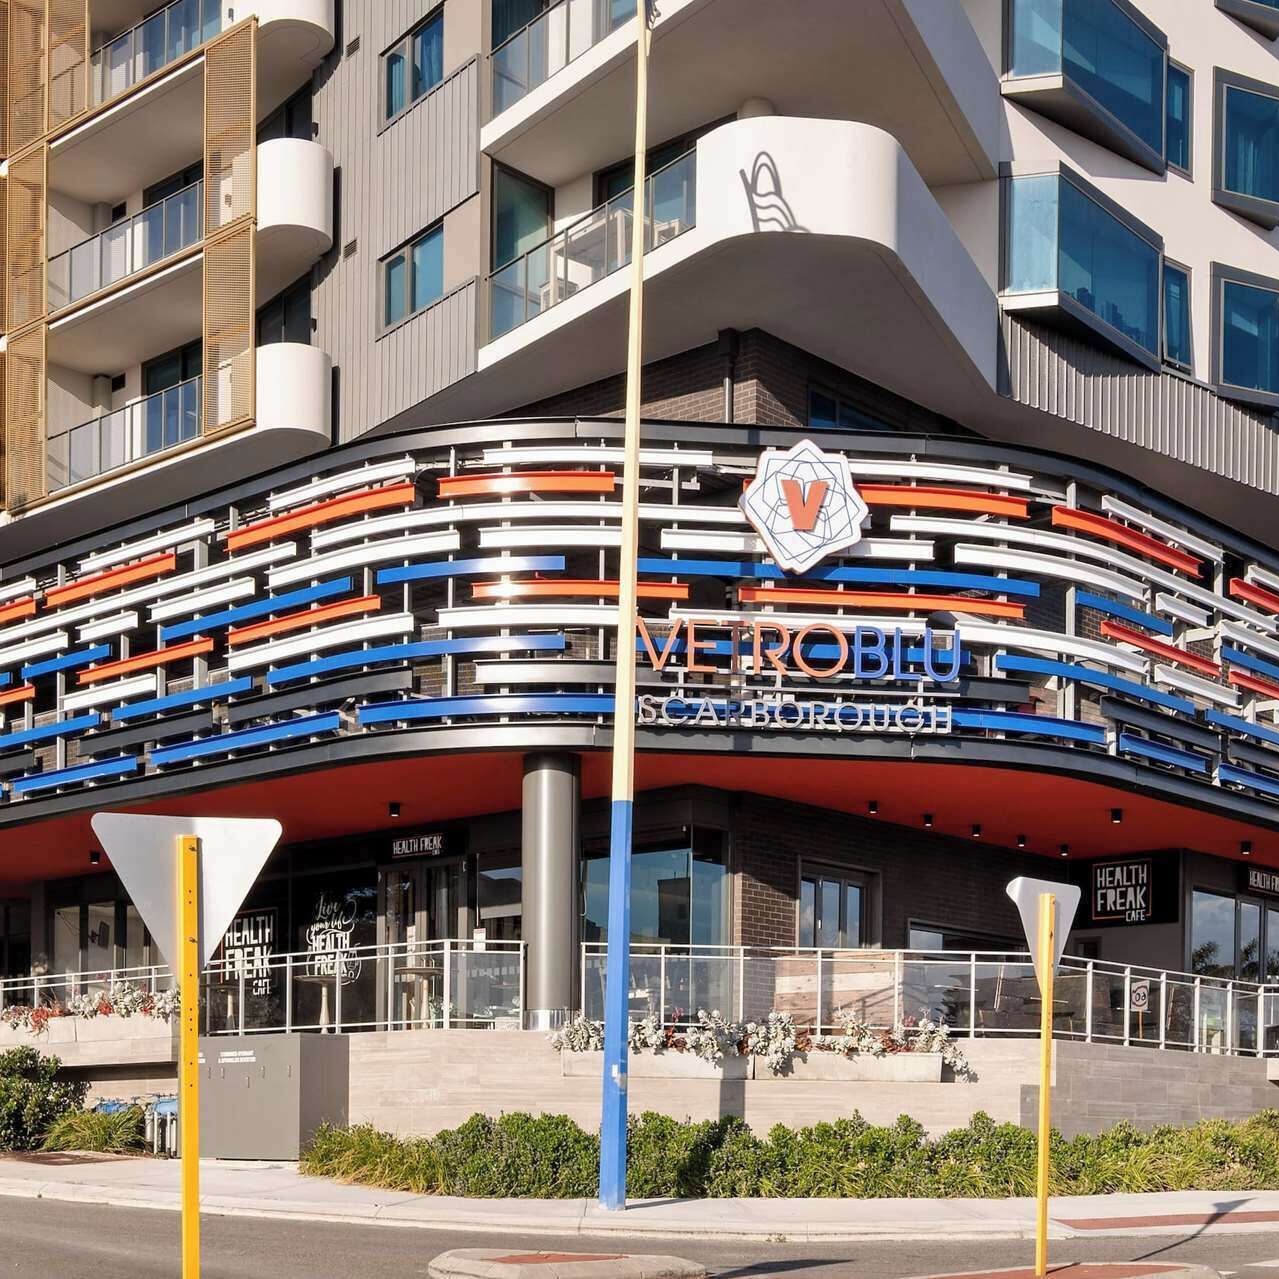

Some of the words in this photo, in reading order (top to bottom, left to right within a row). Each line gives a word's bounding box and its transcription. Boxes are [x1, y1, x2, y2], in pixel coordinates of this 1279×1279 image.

[780, 479, 830, 532] V
[635, 616, 961, 683] VETROBLU
[637, 693, 953, 734] SCARBOROUGH
[393, 838, 419, 855] HEALTH
[419, 835, 442, 851] FREAK
[1096, 863, 1147, 888] HEALTH
[1096, 886, 1146, 912] FREAK
[1125, 908, 1146, 922] CAFE
[225, 914, 273, 947] HEALTH
[312, 931, 350, 953] HEALTH
[225, 945, 272, 980] FREAK
